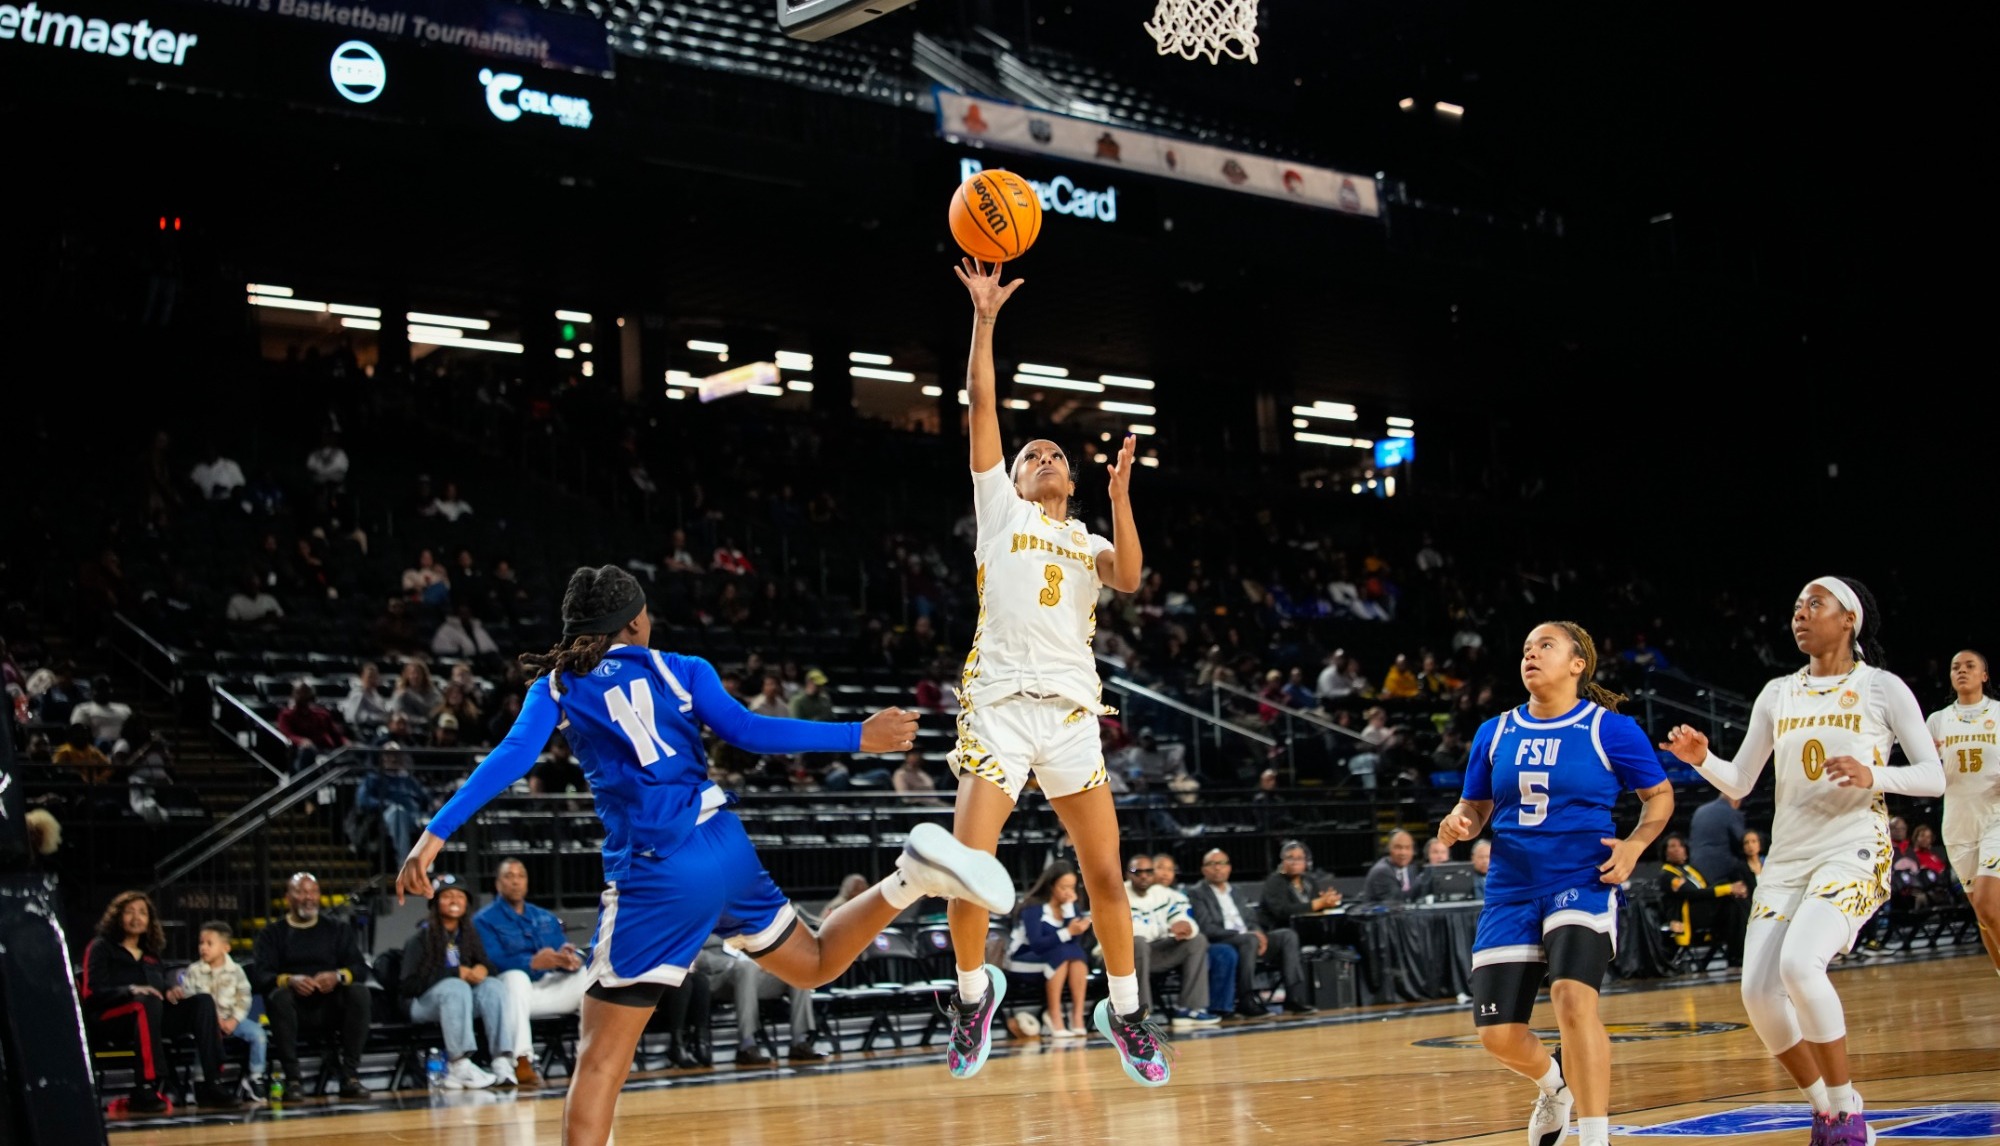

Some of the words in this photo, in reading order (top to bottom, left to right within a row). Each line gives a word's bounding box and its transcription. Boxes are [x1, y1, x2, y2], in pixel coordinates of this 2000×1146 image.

[277, 0, 406, 35] Basketball
[412, 15, 550, 60] Tournament
[973, 177, 1008, 236] Wilson
[1039, 564, 1064, 607] 3
[603, 677, 678, 767] 11
[1818, 713, 1862, 734] STATE
[1514, 738, 1562, 766] FSU
[1801, 738, 1826, 781] 0
[1956, 748, 1983, 774] 15
[1518, 771, 1550, 827] 5
